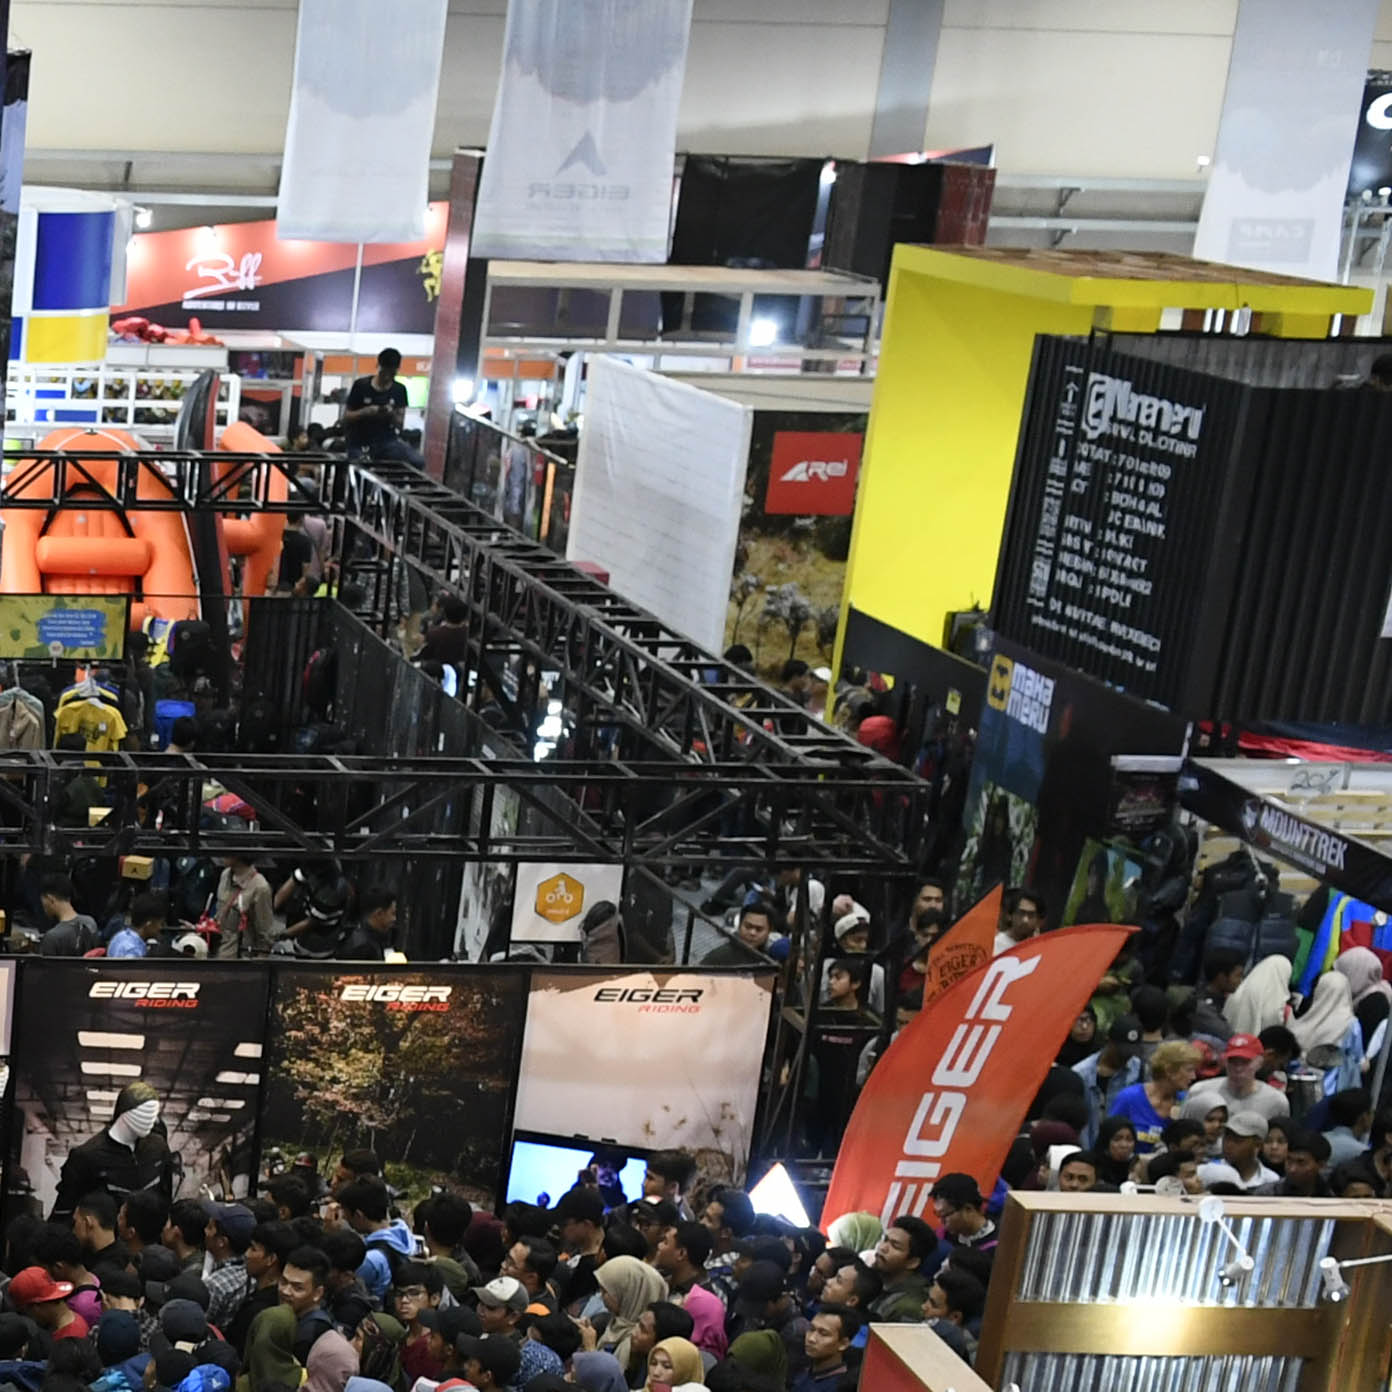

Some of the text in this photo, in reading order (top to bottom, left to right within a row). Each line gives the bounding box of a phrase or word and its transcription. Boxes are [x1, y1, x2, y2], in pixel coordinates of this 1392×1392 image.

[88, 981, 201, 999] EIGER
[340, 985, 453, 1003] EIGER
[594, 987, 704, 1004] EIGER
[134, 999, 198, 1009] RIDING
[385, 1002, 450, 1013] RIDING
[637, 1004, 701, 1014] RIDING
